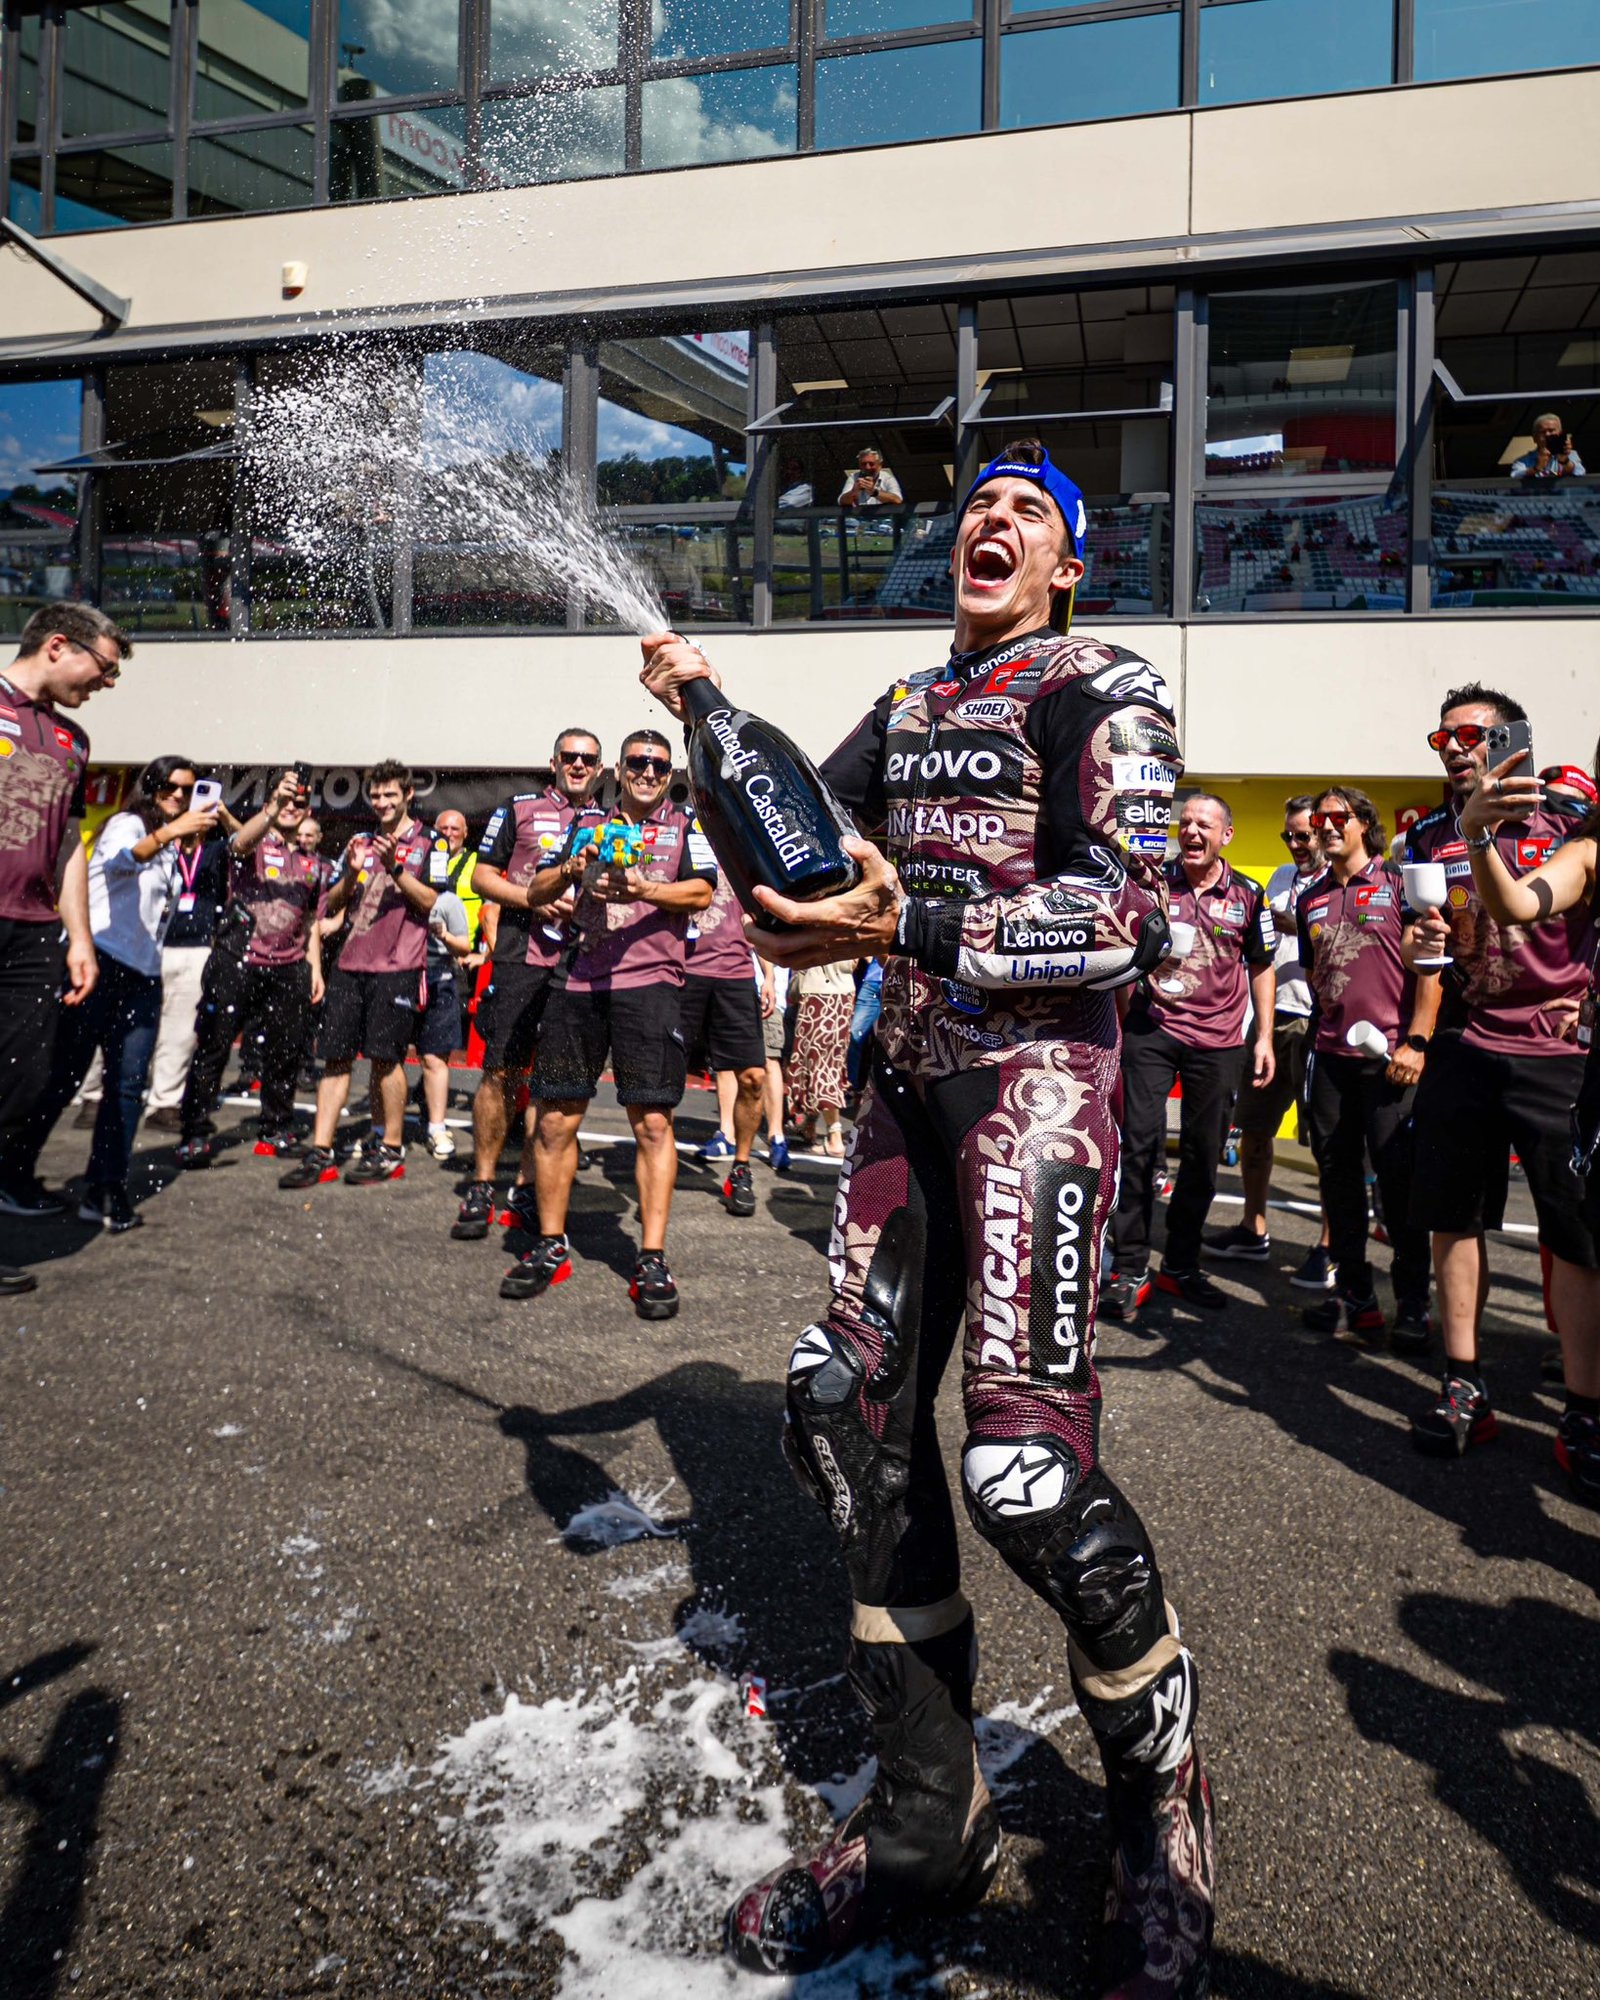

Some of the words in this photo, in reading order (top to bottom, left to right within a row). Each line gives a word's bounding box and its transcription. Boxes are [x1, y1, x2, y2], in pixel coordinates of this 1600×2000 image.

[995, 464, 1040, 474] MICHELIN
[969, 642, 1026, 679] Lenovo
[1014, 670, 1042, 678] Lenovo
[963, 702, 1006, 716] SHOEI
[1140, 762, 1175, 784] riello
[706, 708, 758, 773] Contadi
[745, 774, 810, 872] Castaldi
[893, 806, 1005, 843] NetApp
[1125, 800, 1171, 824] elica
[1003, 927, 1087, 948] Lenovo
[1011, 955, 1085, 983] Unipol
[981, 1164, 1022, 1376] DUCATI
[1048, 1182, 1084, 1375] Lenovo
